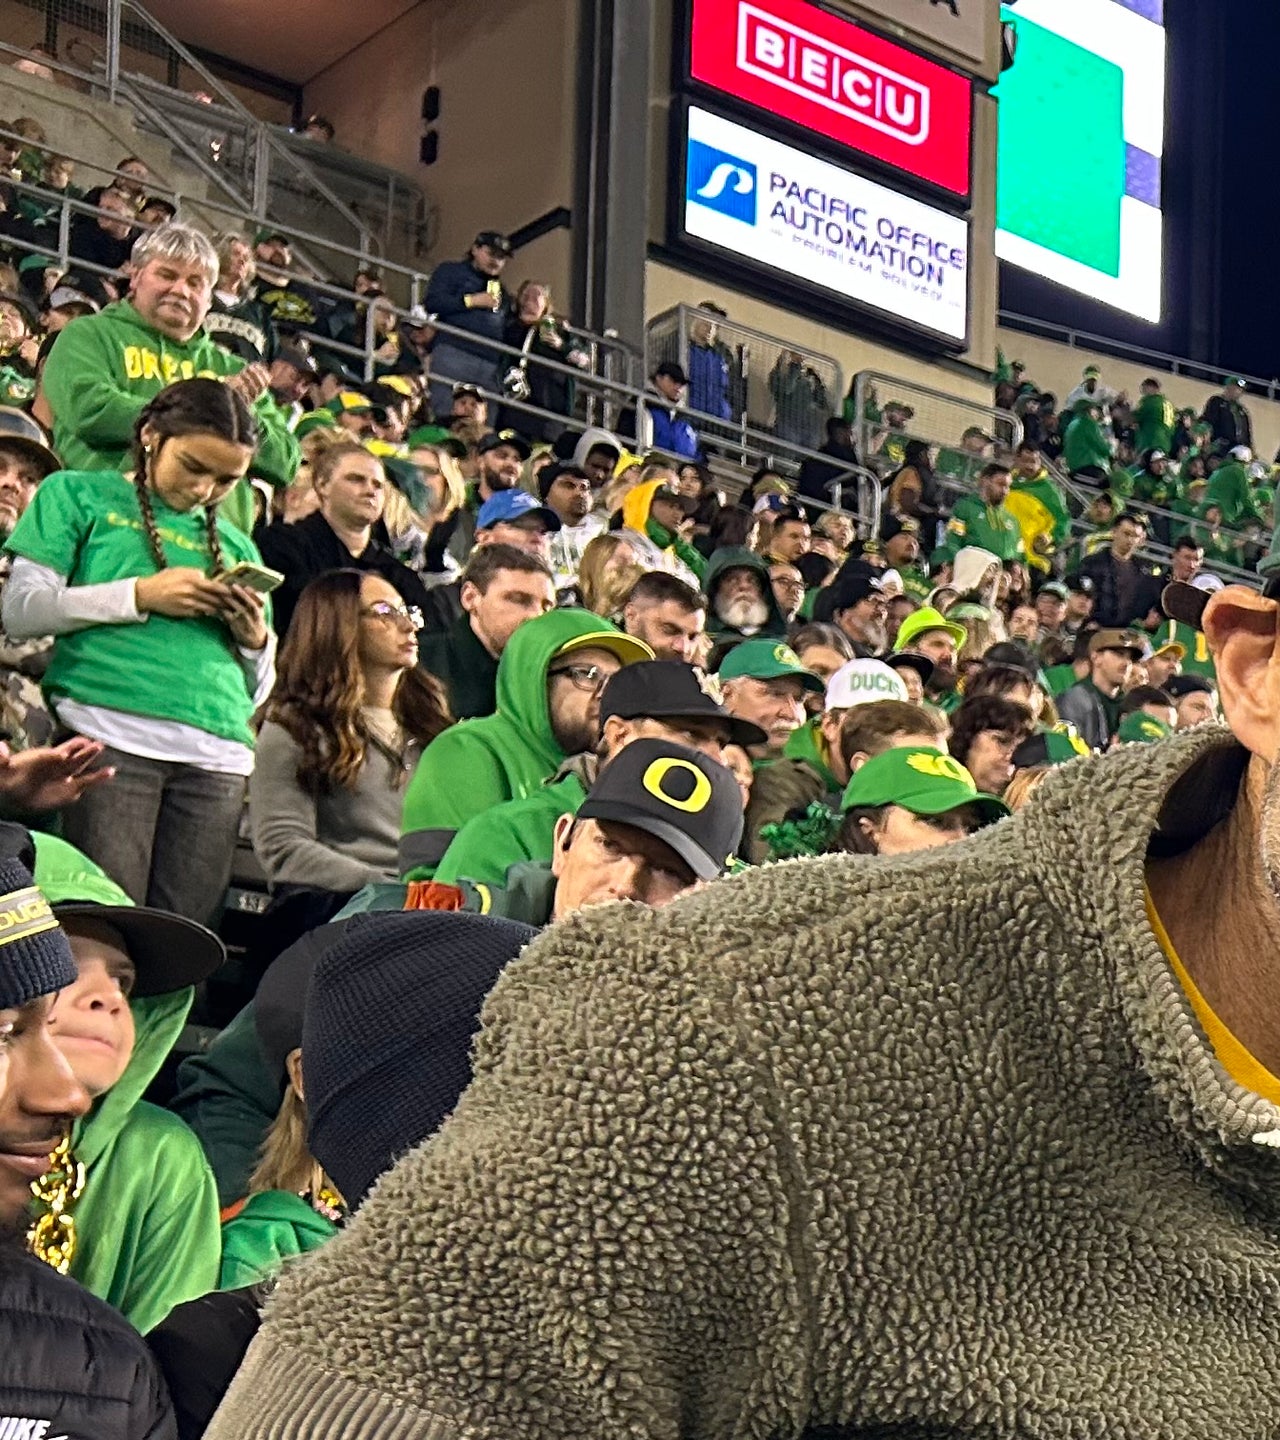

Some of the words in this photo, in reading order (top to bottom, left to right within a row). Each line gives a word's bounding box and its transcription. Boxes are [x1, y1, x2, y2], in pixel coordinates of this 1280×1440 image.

[769, 171, 867, 230] PACIFIC
[877, 216, 965, 270] OFFICE
[770, 200, 944, 286] AUTOMATION
